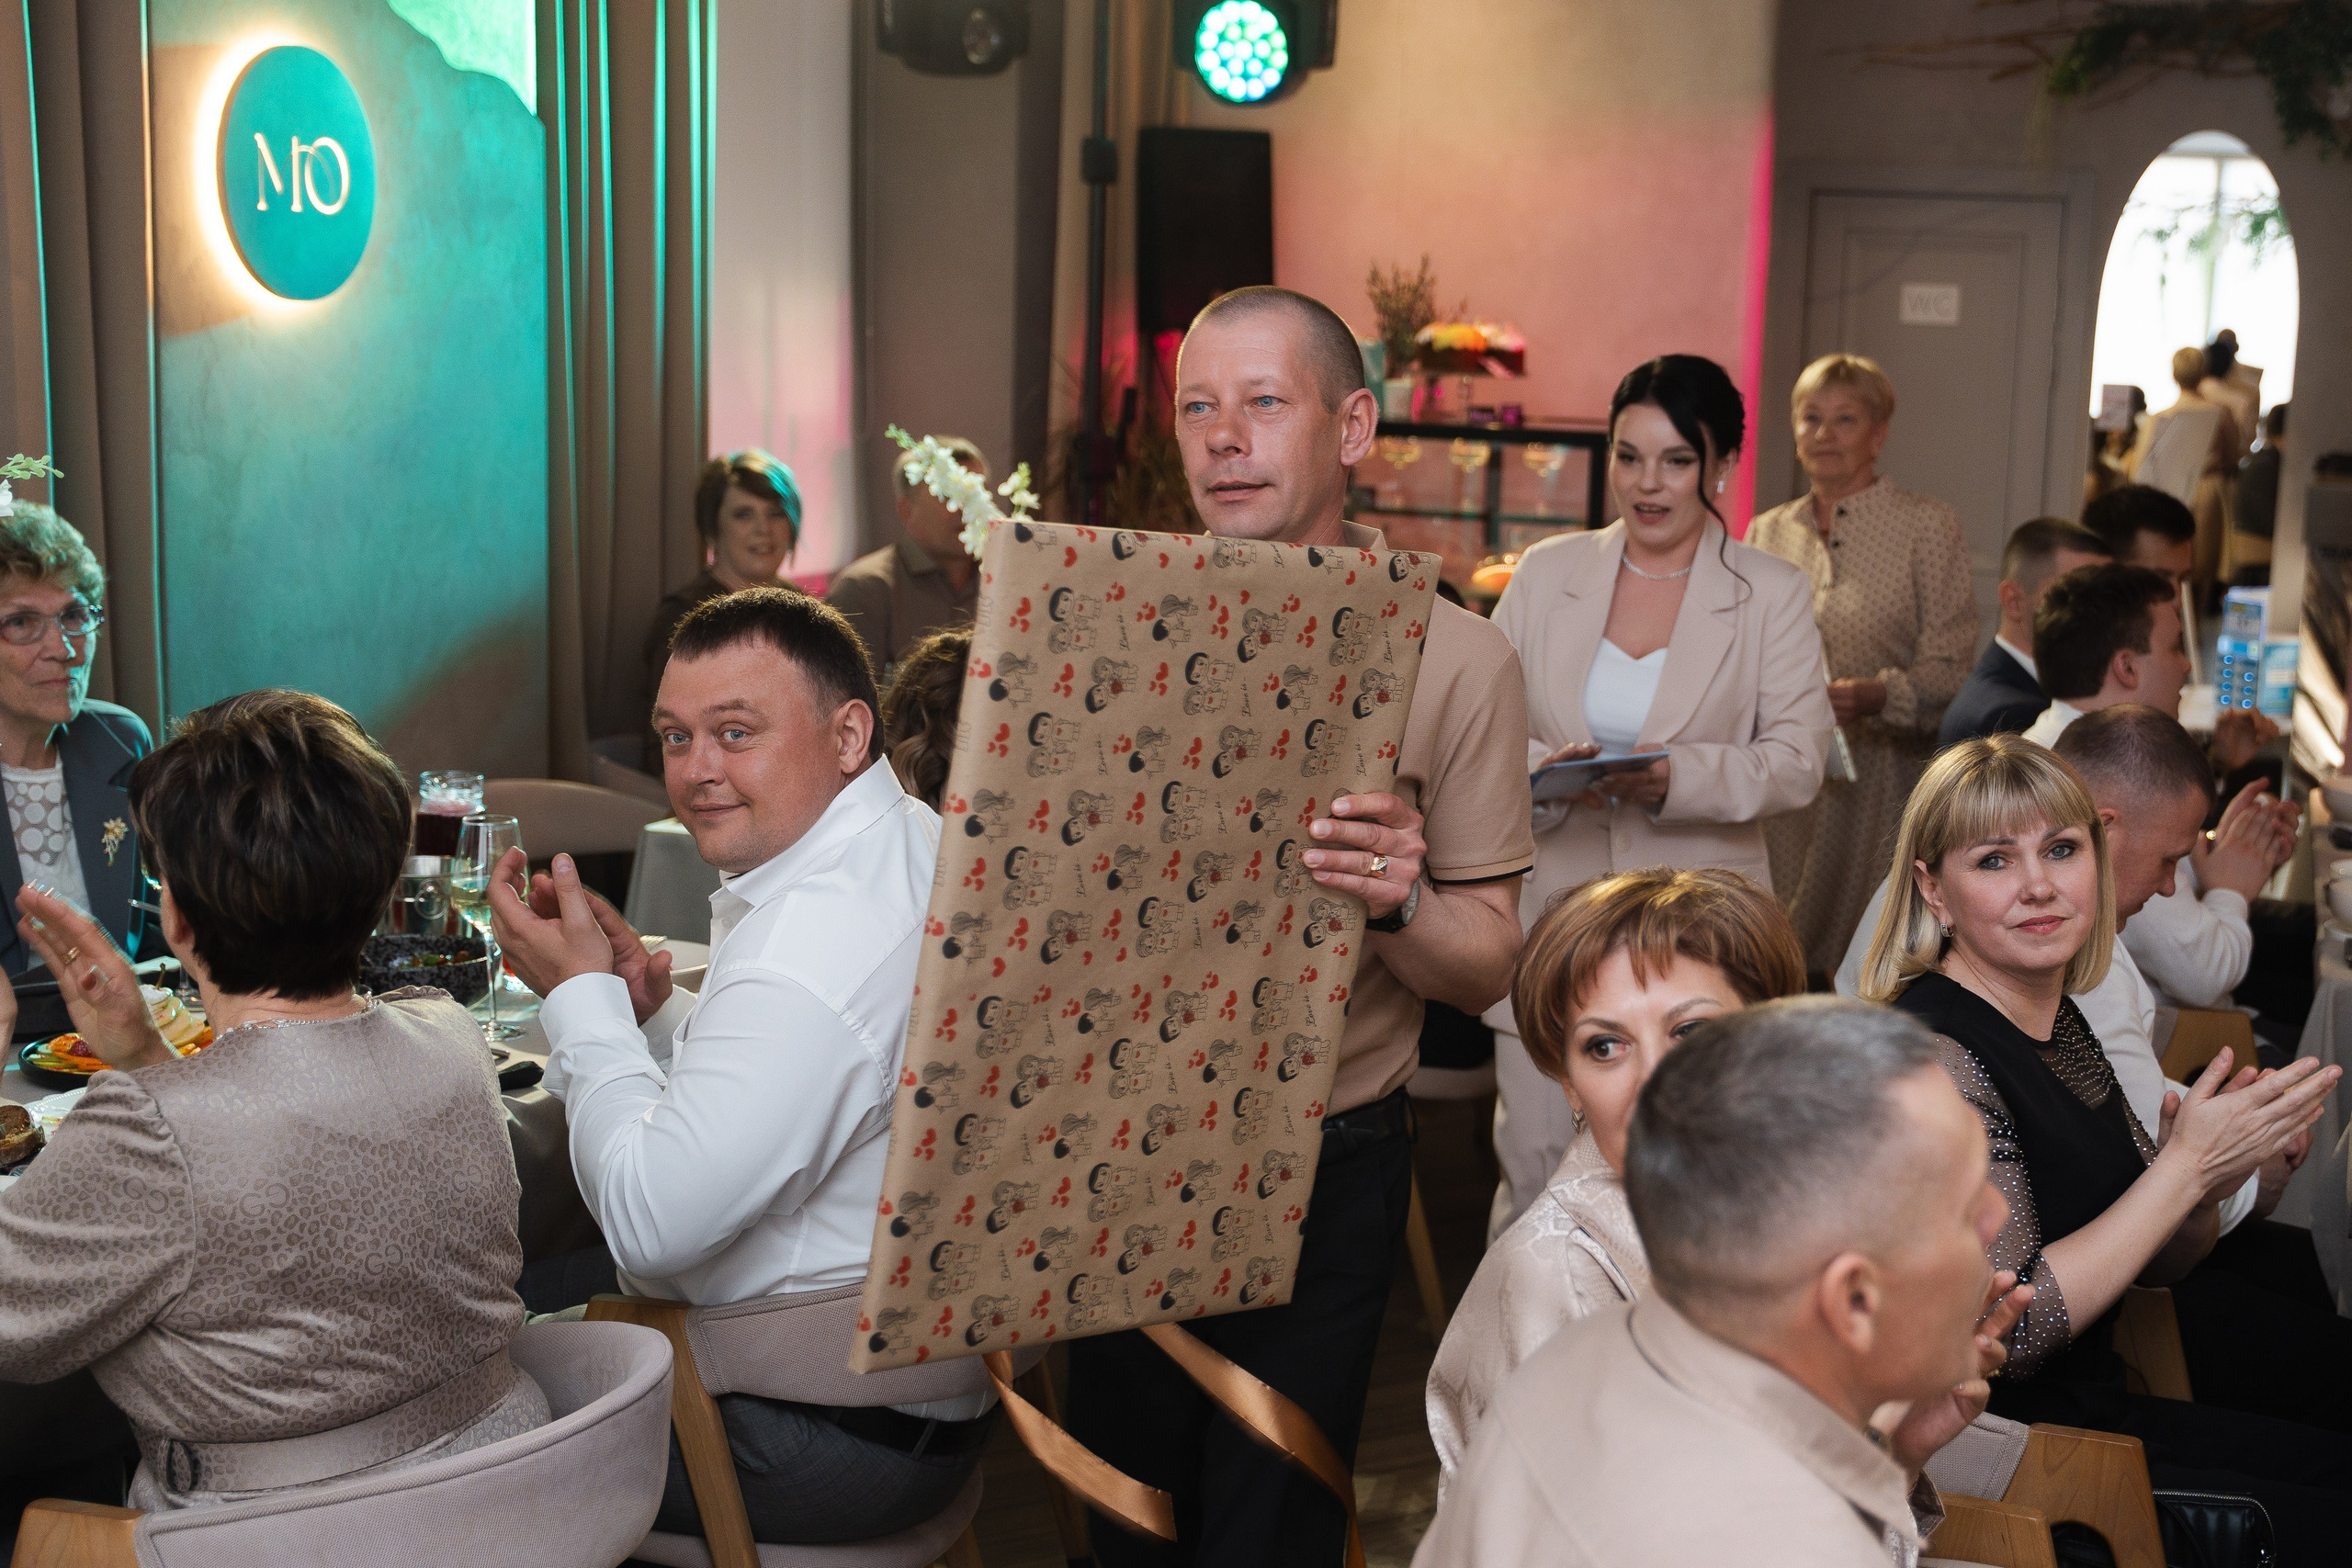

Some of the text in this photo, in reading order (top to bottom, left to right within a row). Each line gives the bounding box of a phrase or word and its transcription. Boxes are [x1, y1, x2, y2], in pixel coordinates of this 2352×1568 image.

[1907, 294, 1950, 316] WC
[1120, 626, 1130, 651] Love
[1384, 640, 1394, 664] Love
[1242, 694, 1251, 717] Love
[1098, 750, 1108, 775] Love
[1356, 753, 1367, 777] Love
[1218, 811, 1227, 835] Love
[1077, 874, 1087, 897] Love
[1193, 927, 1203, 949] Love
[1306, 1004, 1317, 1027] Love
[1045, 1023, 1056, 1046] Love
[1168, 1072, 1179, 1094] Love
[1284, 1114, 1295, 1136] Love
[1023, 1143, 1034, 1165] Love
